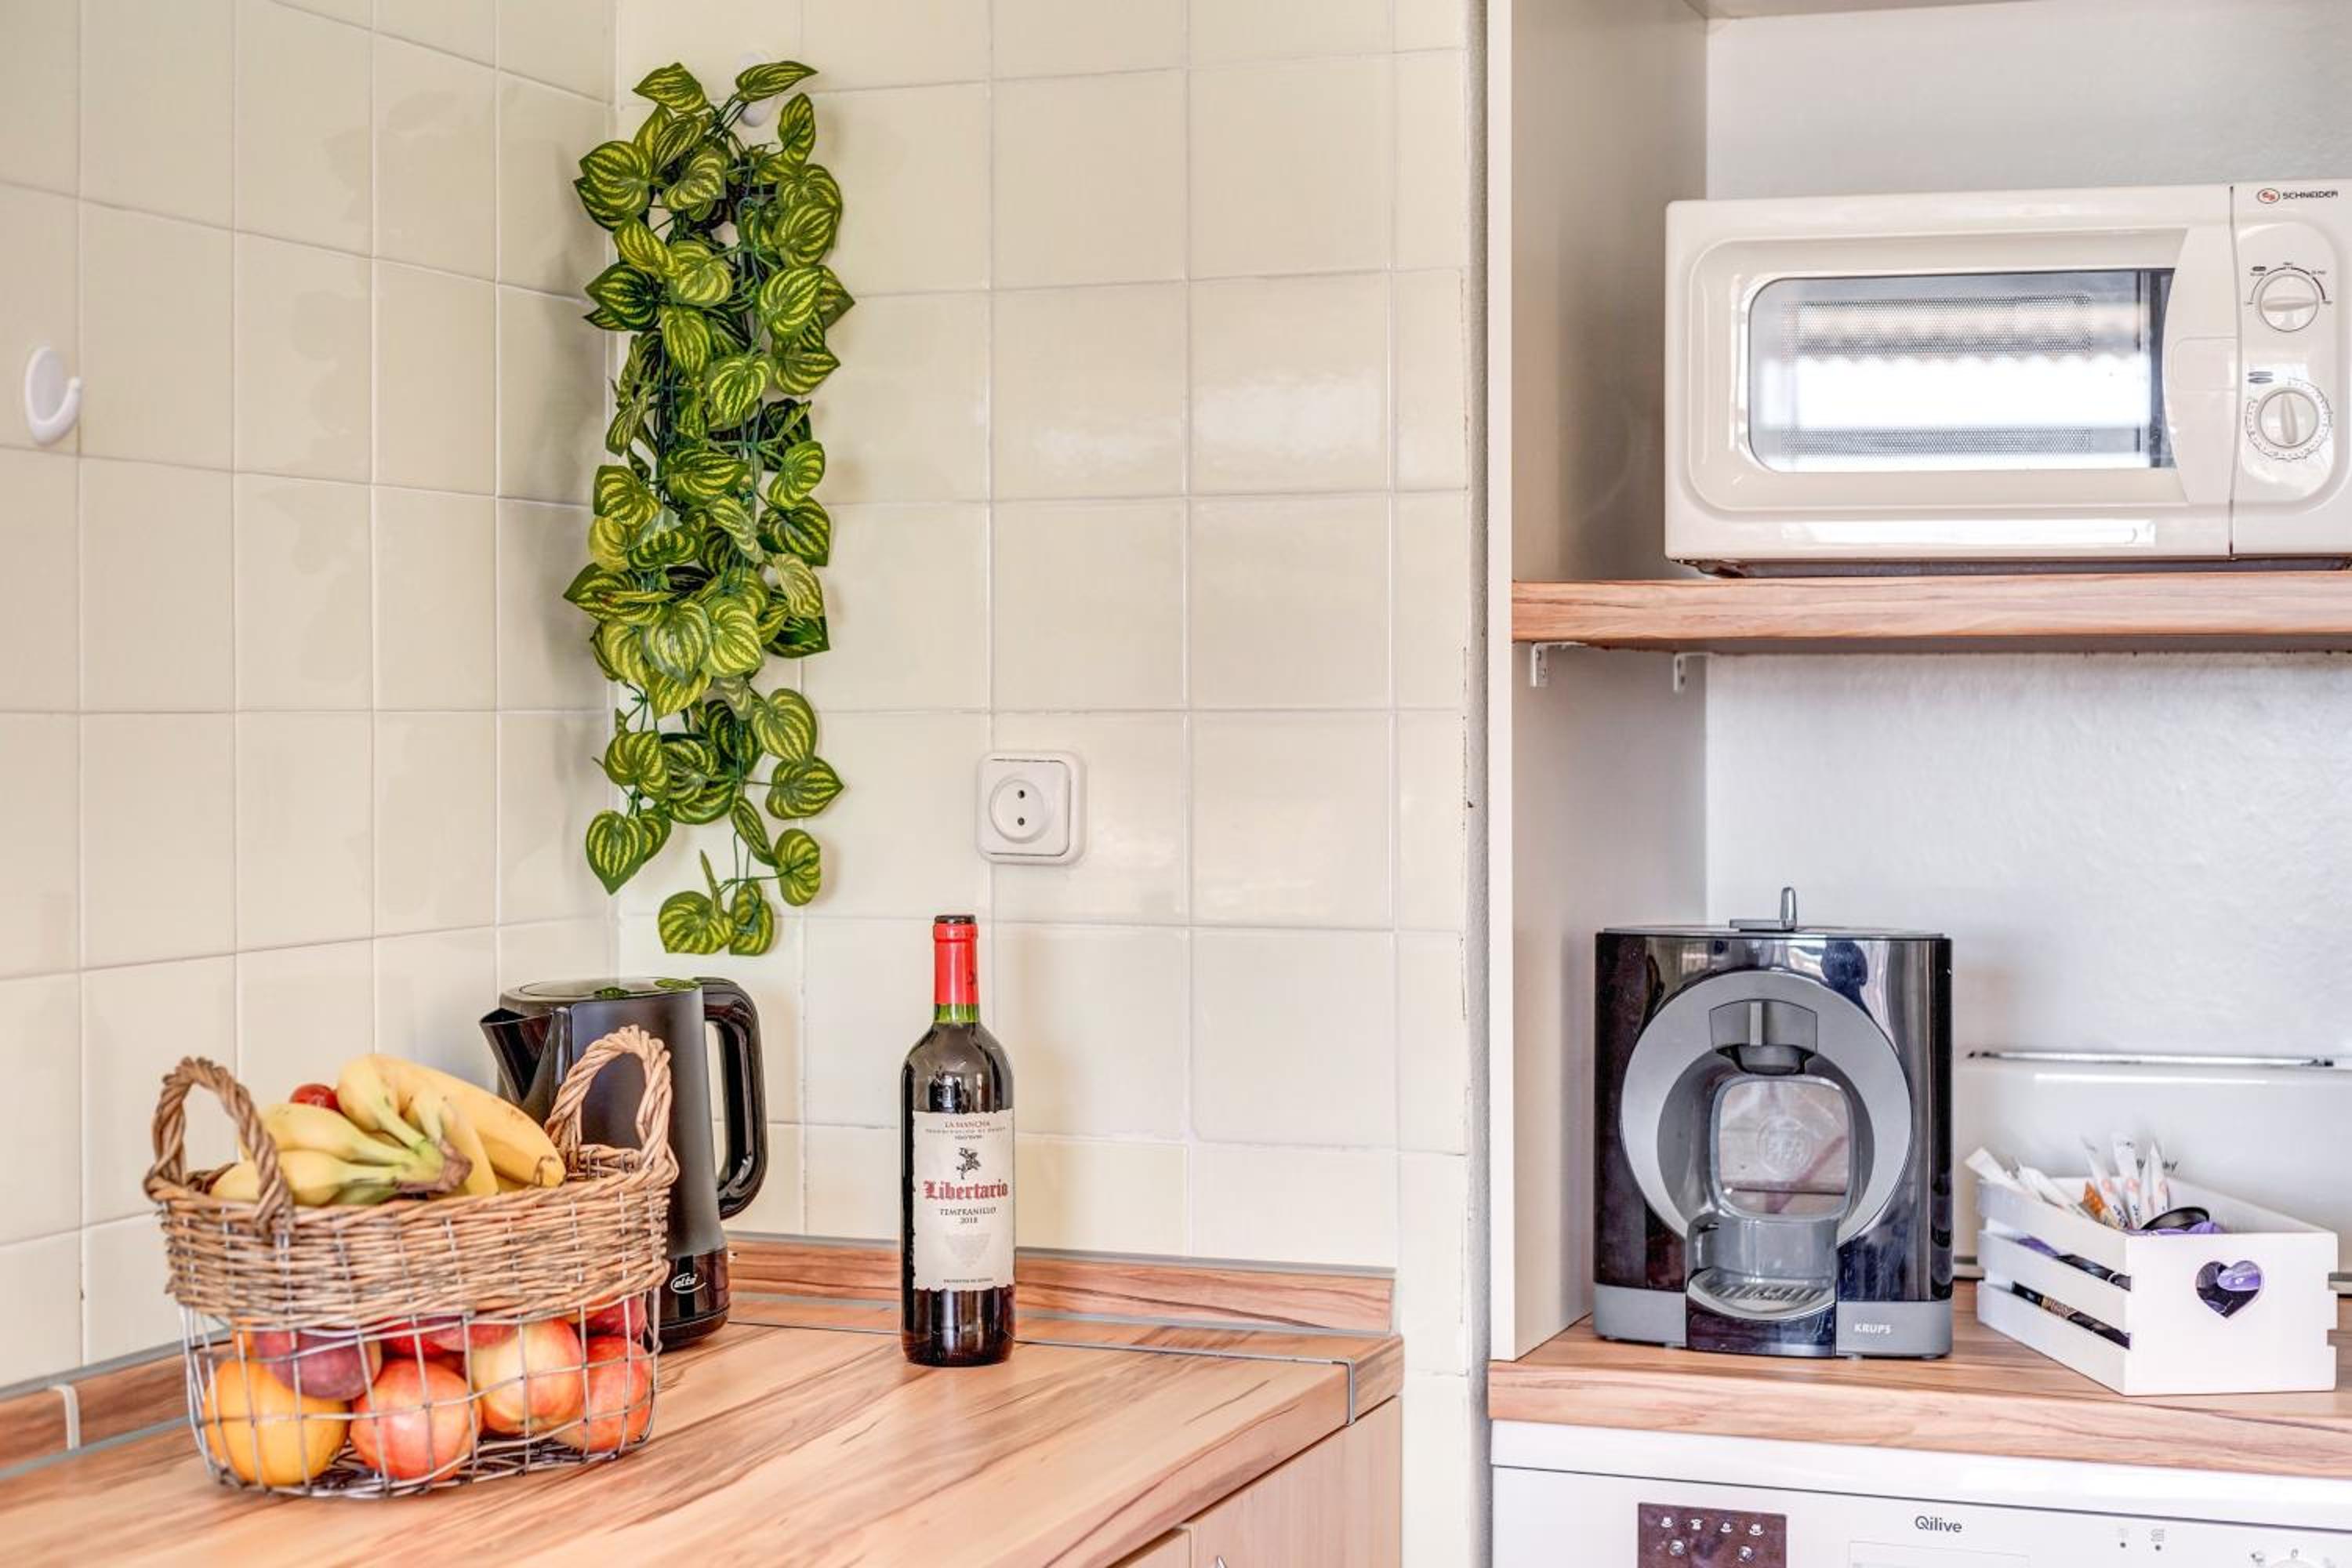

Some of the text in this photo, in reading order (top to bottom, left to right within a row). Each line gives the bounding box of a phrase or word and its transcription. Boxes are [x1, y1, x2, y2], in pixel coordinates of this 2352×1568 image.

[2282, 191, 2338, 199] SCHNEIDER
[924, 1178, 1008, 1200] Libertario
[940, 1207, 996, 1216] TEMPRANILLO
[1855, 1323, 1891, 1334] KRUPS
[1915, 1515, 1962, 1533] Qilive
